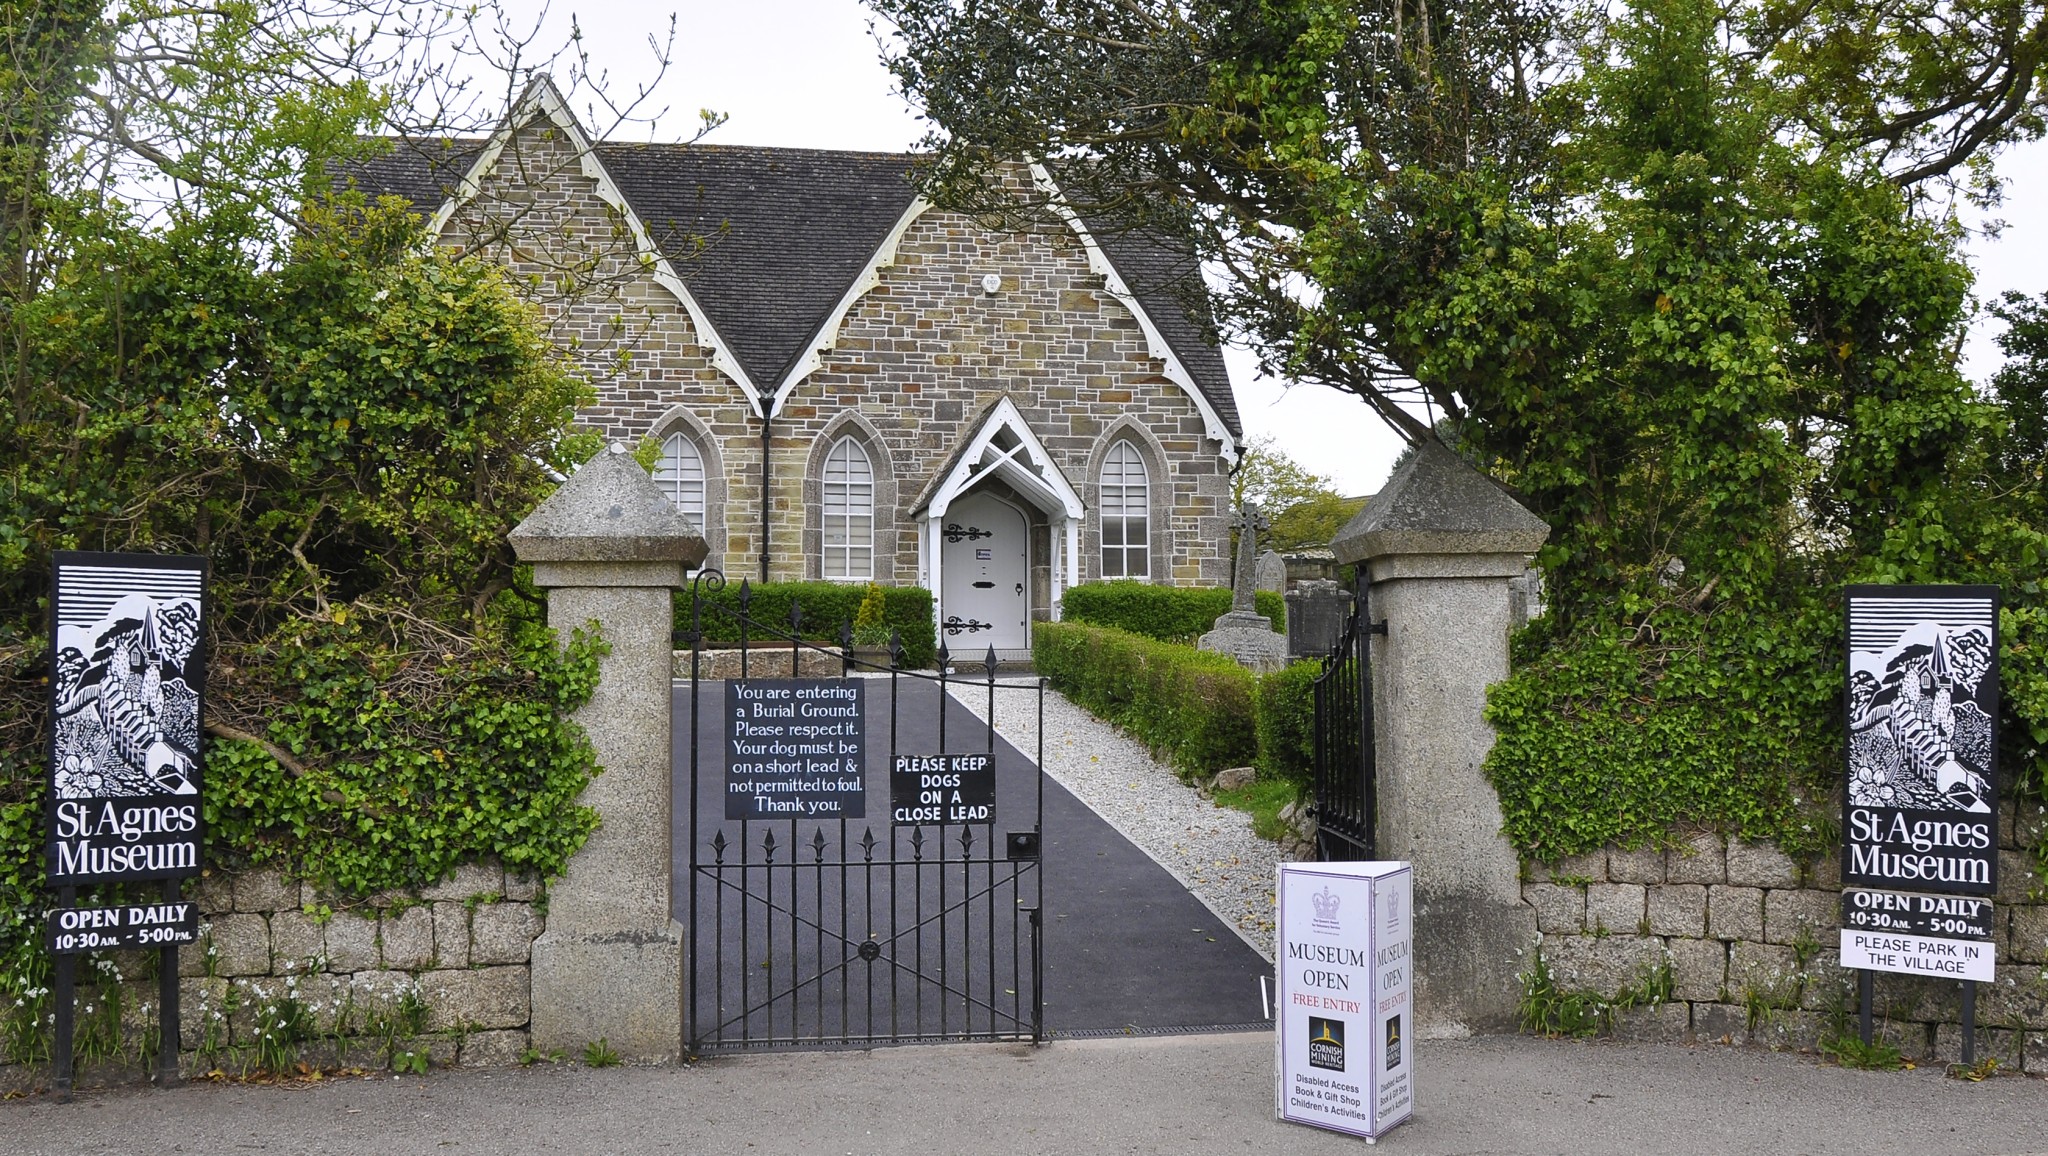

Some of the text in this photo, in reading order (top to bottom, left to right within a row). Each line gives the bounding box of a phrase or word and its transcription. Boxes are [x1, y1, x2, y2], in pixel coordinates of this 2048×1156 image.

[735, 684, 857, 700] You are entering
[736, 702, 859, 718] a Burial Ground.
[736, 721, 858, 739] Please respect it.
[733, 740, 858, 757] Your dog must be
[732, 758, 858, 773] on a short lead &
[896, 757, 986, 772] PLEASE KEEP
[729, 777, 862, 795] not permitted to foul.
[921, 774, 960, 788] DOGS
[754, 796, 840, 814] Thank you.
[920, 790, 962, 804] ON A
[57, 801, 196, 842] St Agnes
[895, 806, 988, 821] CLOSE LEAD
[1850, 809, 1990, 852] St Agnes
[56, 840, 197, 875] Museum
[1849, 844, 1990, 884] Museum
[1854, 892, 1981, 917] OPEN DAILY
[60, 905, 188, 930] OPEN DAILY
[1289, 942, 1364, 967] MUSEUM
[1377, 940, 1408, 968] MUSEUM
[1855, 936, 1979, 959] PLEASE PARK IN
[1868, 953, 1965, 973] THE VILLAGE
[1304, 969, 1349, 991] OPEN
[1383, 967, 1402, 990] OPEN
[1293, 993, 1360, 1013] FREE ENTRY
[1379, 991, 1406, 1014] FREE ENTRY
[1311, 1043, 1342, 1056] CORNISH
[1311, 1051, 1343, 1064] MINING
[1296, 1074, 1359, 1093] Disabled Access
[1296, 1086, 1360, 1108] Book & Gift Shop
[1291, 1098, 1366, 1120] Children's Activities
